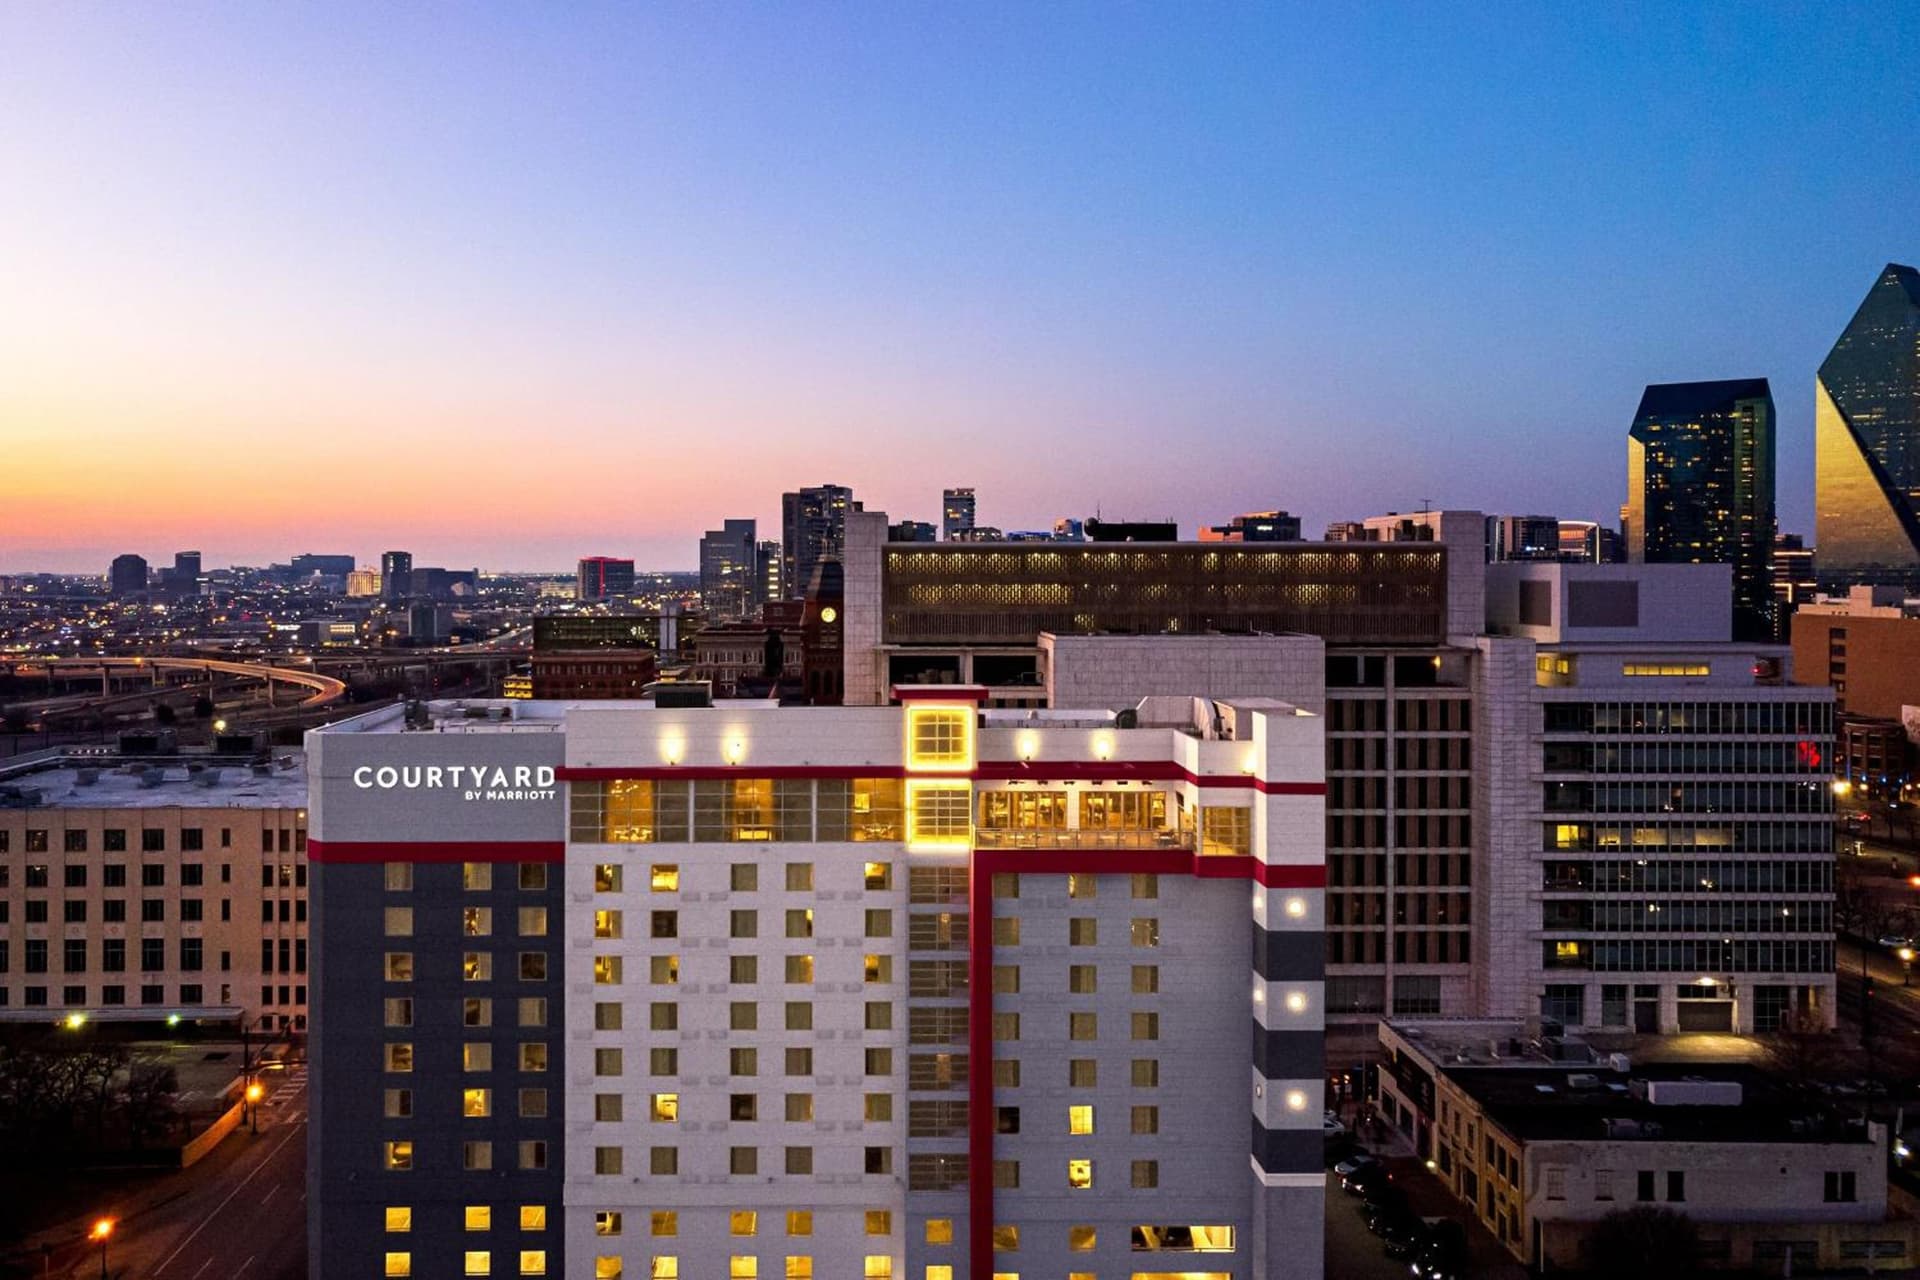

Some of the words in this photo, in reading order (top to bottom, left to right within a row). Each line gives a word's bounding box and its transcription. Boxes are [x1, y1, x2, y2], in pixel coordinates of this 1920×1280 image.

[353, 766, 555, 788] COURTYARD
[464, 790, 482, 800] BY
[486, 790, 556, 800] MARRIOTT
